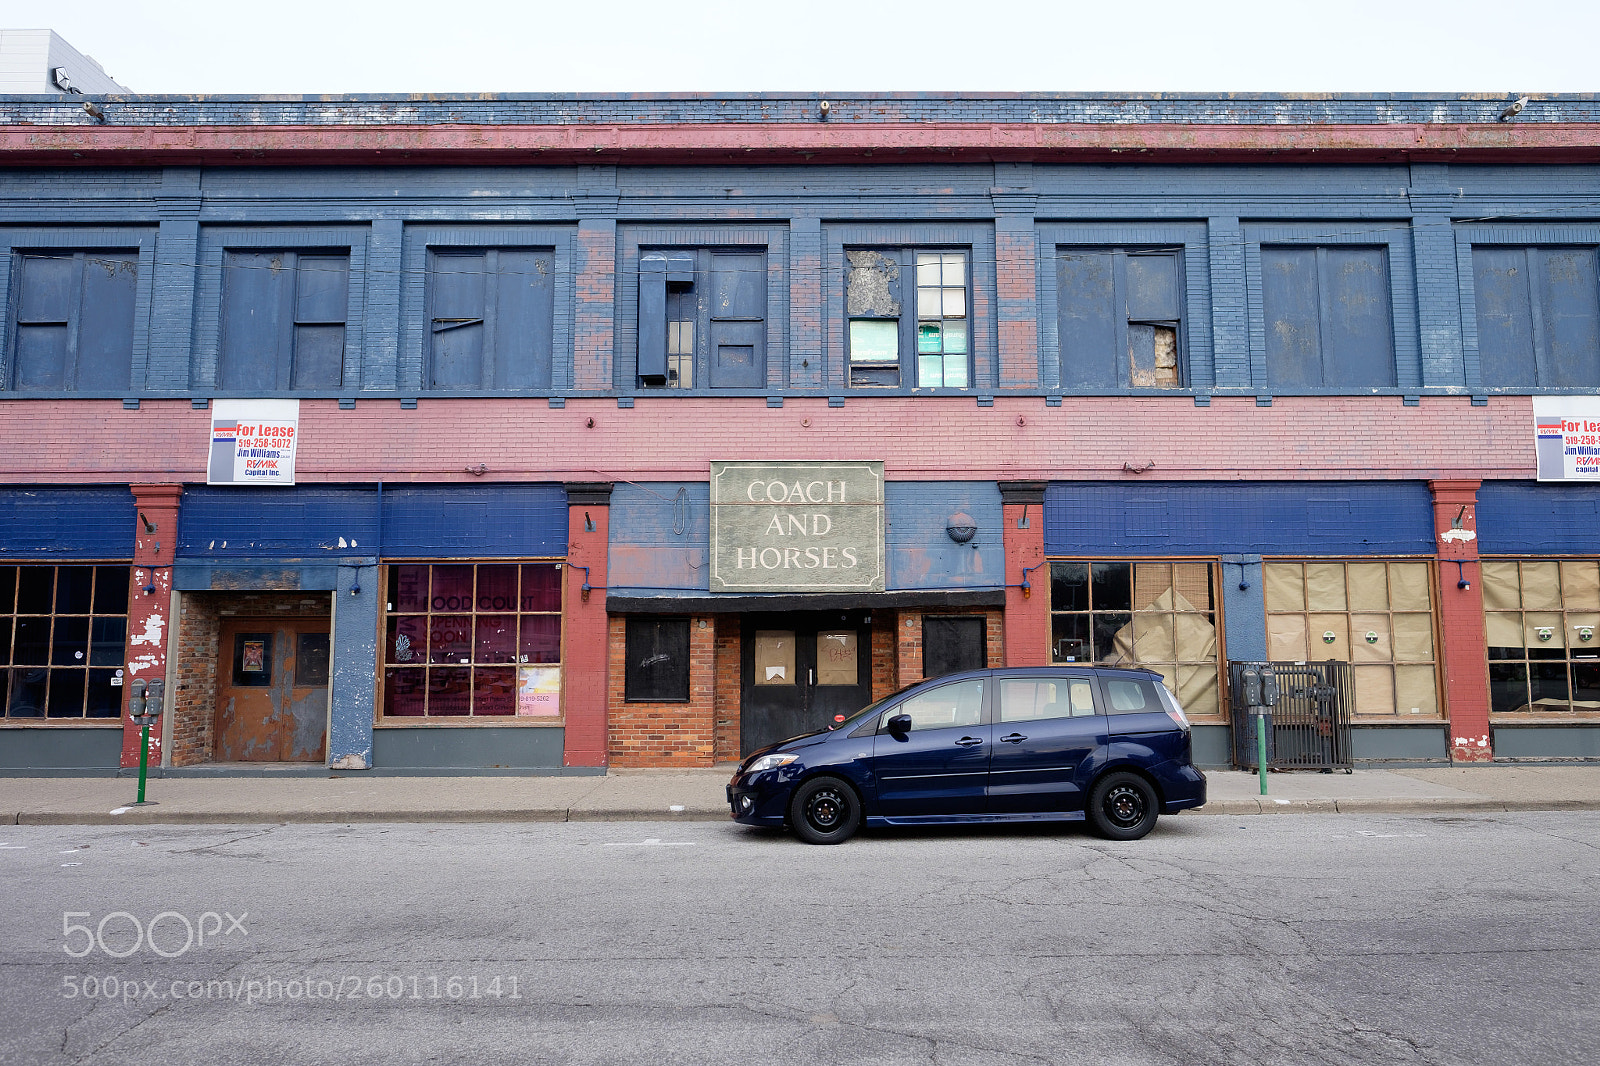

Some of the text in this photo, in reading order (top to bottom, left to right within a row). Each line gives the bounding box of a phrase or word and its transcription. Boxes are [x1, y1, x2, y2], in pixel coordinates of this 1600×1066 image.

[236, 424, 294, 437] For Lease
[1561, 420, 1580, 432] For
[238, 438, 291, 448] 519-258-5072
[237, 448, 249, 457] Jim
[250, 448, 280, 458] Williams
[1565, 446, 1576, 455] Jim
[246, 459, 278, 468] RE/MAX
[747, 480, 846, 503] COACH
[764, 513, 832, 536] AND
[737, 547, 857, 569] HORSES
[401, 571, 418, 605] THE
[423, 615, 502, 628] OPENNNG
